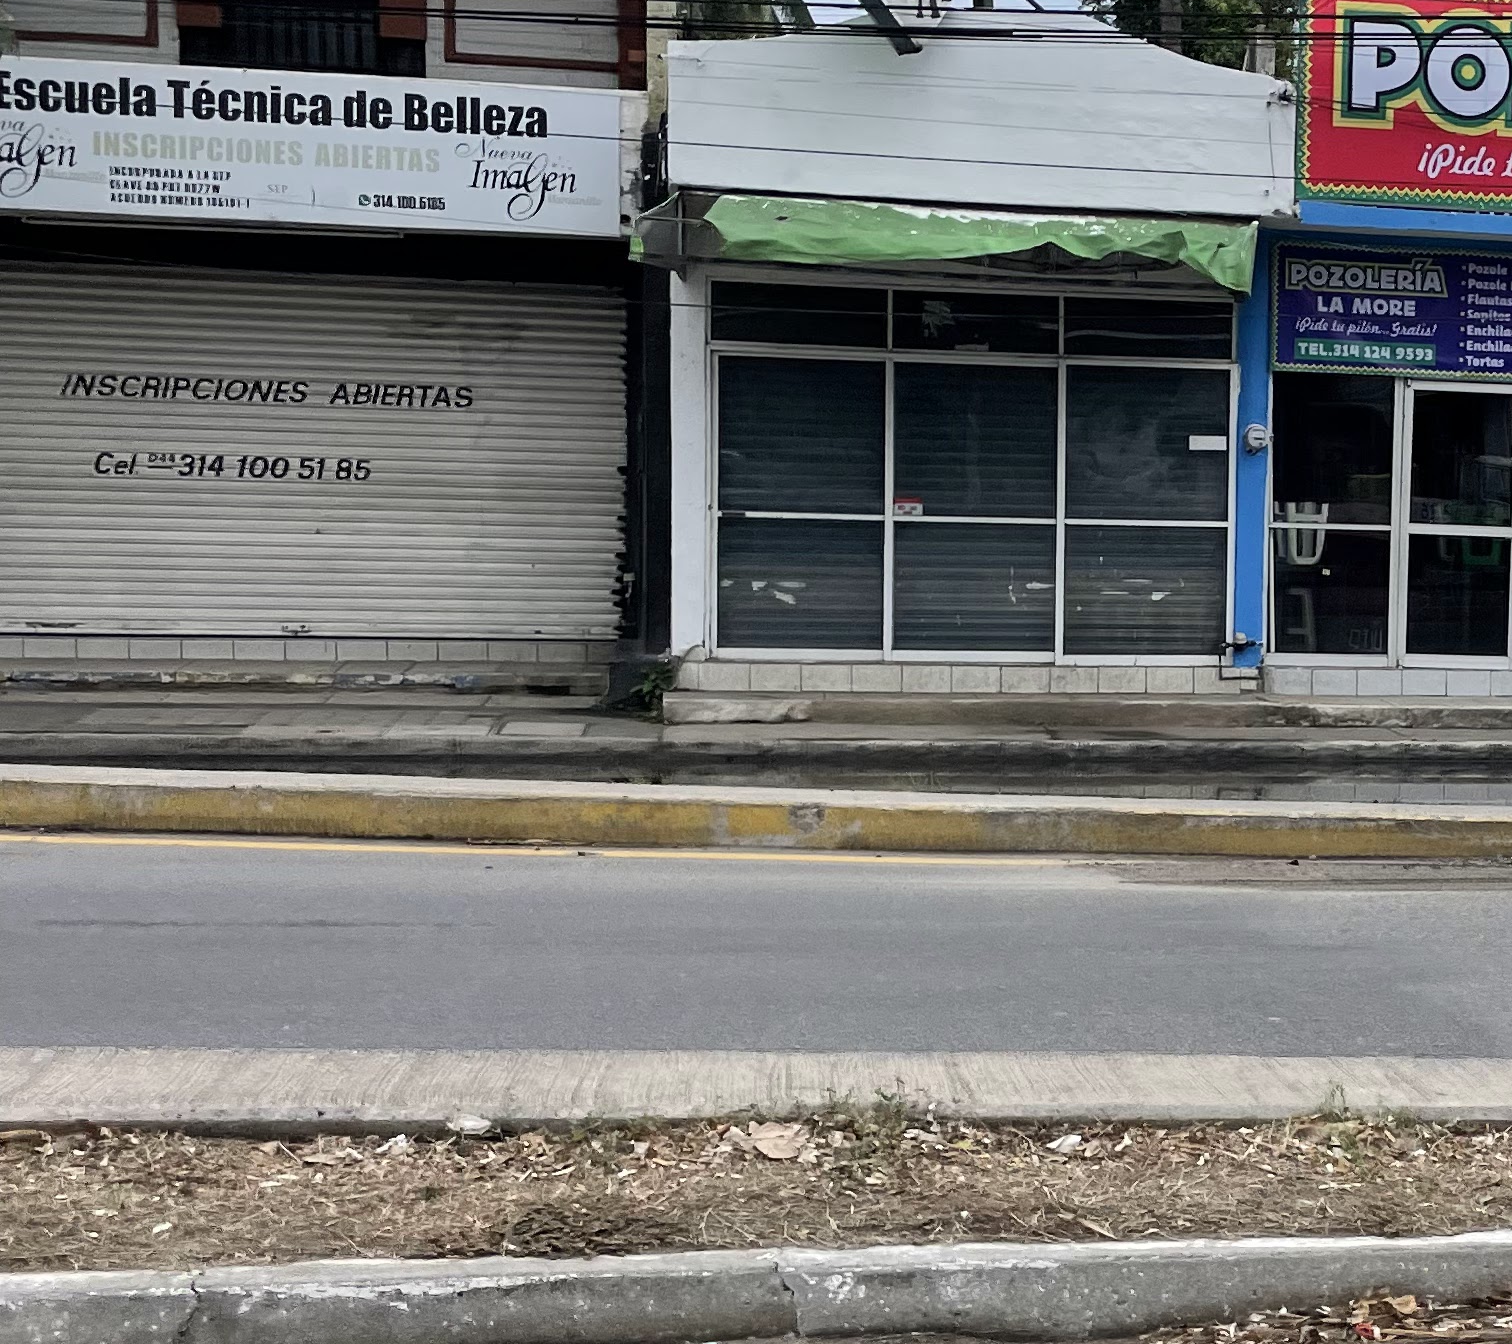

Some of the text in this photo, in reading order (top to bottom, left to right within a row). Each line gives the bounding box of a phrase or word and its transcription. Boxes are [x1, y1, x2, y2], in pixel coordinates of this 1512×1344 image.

[0, 70, 548, 138] Escuela Técnica de Belleza
[93, 131, 440, 173] INSCRIPCIONES ABIERTAS
[1417, 143, 1496, 179] ¡Pide
[1290, 263, 1442, 292] POZOLERÍA
[1468, 263, 1507, 276] Pozole
[1467, 278, 1507, 291] Pozole
[1317, 296, 1416, 317] LA MORE
[1467, 294, 1512, 307] Flautas
[1298, 342, 1434, 361] TEL.314 124 9593
[1465, 355, 1505, 368] Tortas
[60, 374, 474, 409] INSCRIPCIONES ABIERTAS
[176, 454, 226, 478] 314
[236, 456, 291, 481] 100
[298, 458, 323, 481] 51
[335, 459, 372, 481] 85
